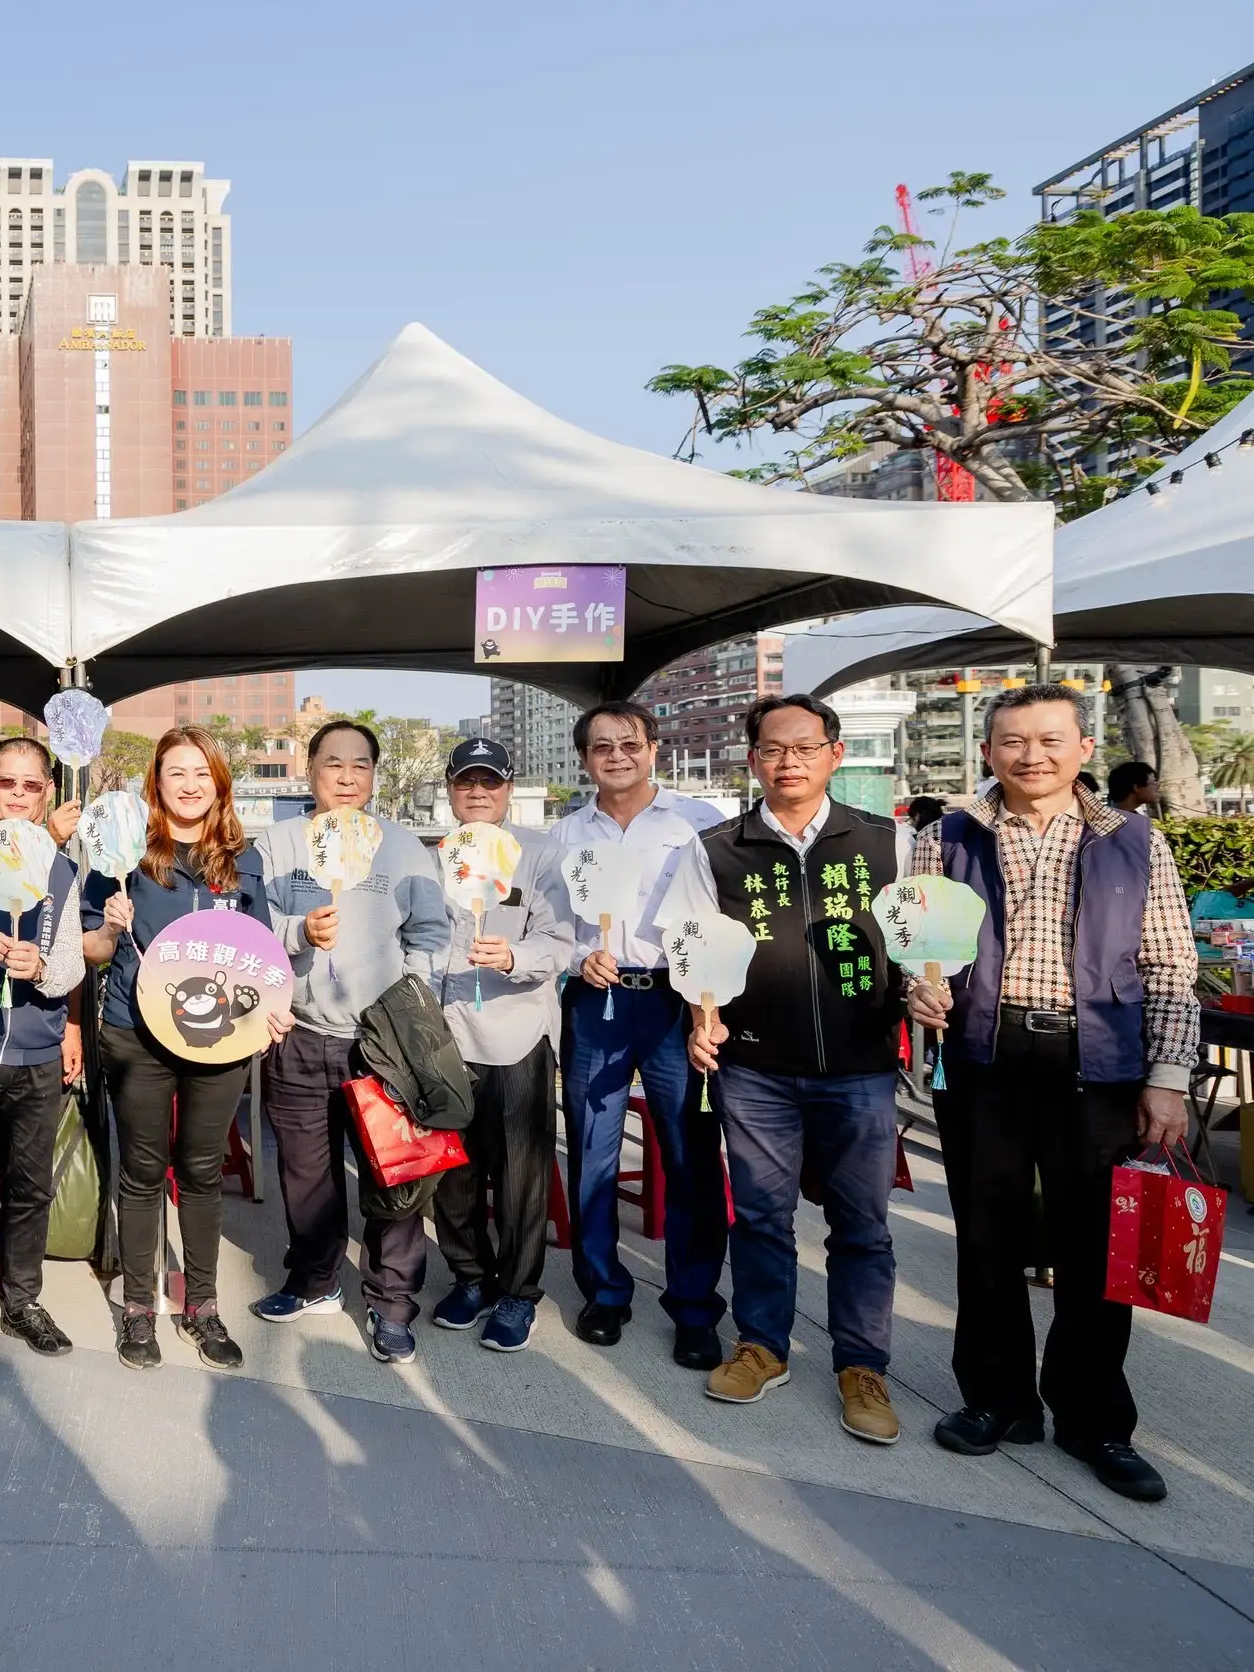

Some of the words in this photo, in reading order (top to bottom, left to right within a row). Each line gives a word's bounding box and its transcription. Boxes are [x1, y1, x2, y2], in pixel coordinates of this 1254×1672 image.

[486, 602, 616, 633] DIY手作
[51, 697, 75, 742] 觀光季
[86, 804, 108, 857] 觀光季
[312, 816, 340, 868] 觀光季
[448, 831, 476, 884] 觀光季
[570, 849, 598, 902] 觀光季
[853, 853, 873, 912] 立法委員
[744, 873, 774, 942] 林恭正
[772, 862, 792, 907] 執行長
[820, 863, 858, 952] 賴瑞隆
[885, 886, 922, 948] 觀光季
[157, 940, 287, 989] 高雄觀光季
[671, 920, 703, 977] 觀光季
[857, 955, 873, 991] 服務
[839, 962, 857, 998] 團隊
[1183, 1223, 1210, 1274] 福
